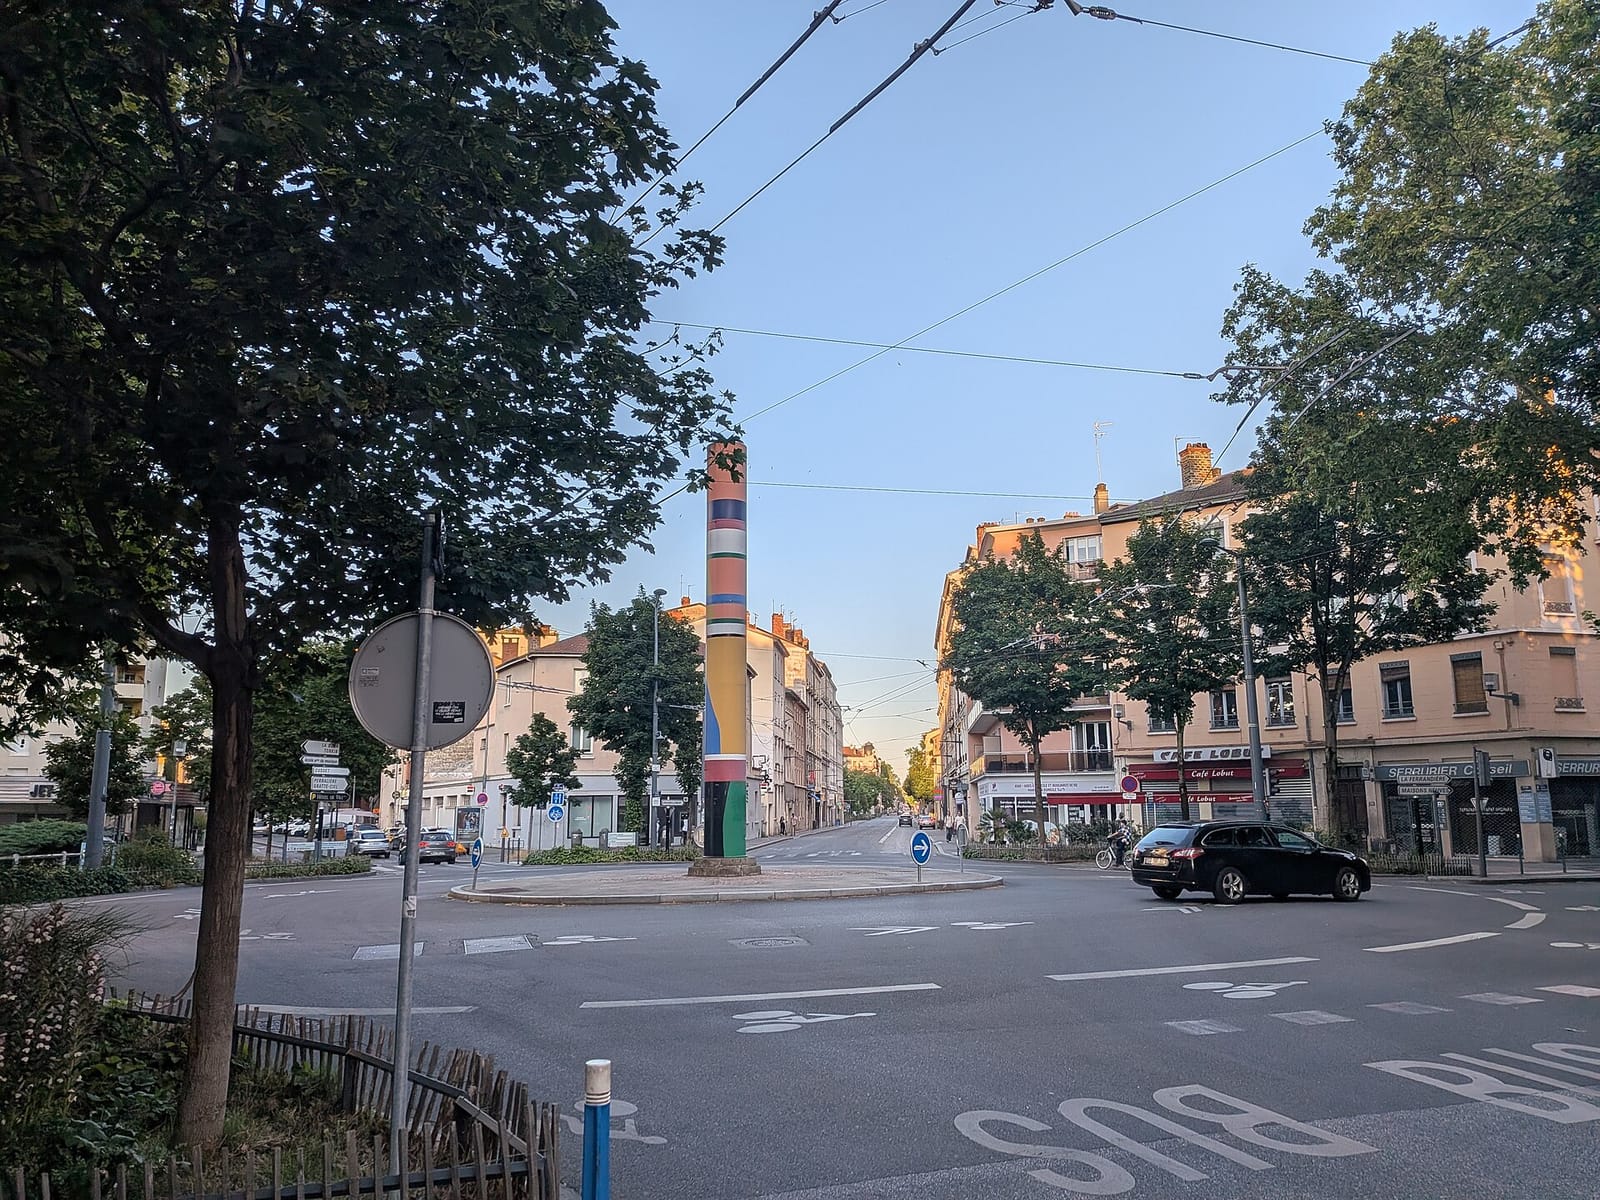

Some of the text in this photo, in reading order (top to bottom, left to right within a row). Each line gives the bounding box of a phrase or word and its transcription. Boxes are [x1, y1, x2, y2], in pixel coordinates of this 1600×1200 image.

[1191, 769, 1234, 778] Café Lobut
[1463, 763, 1513, 775] Cseil
[954, 1084, 1380, 1195] BUS
